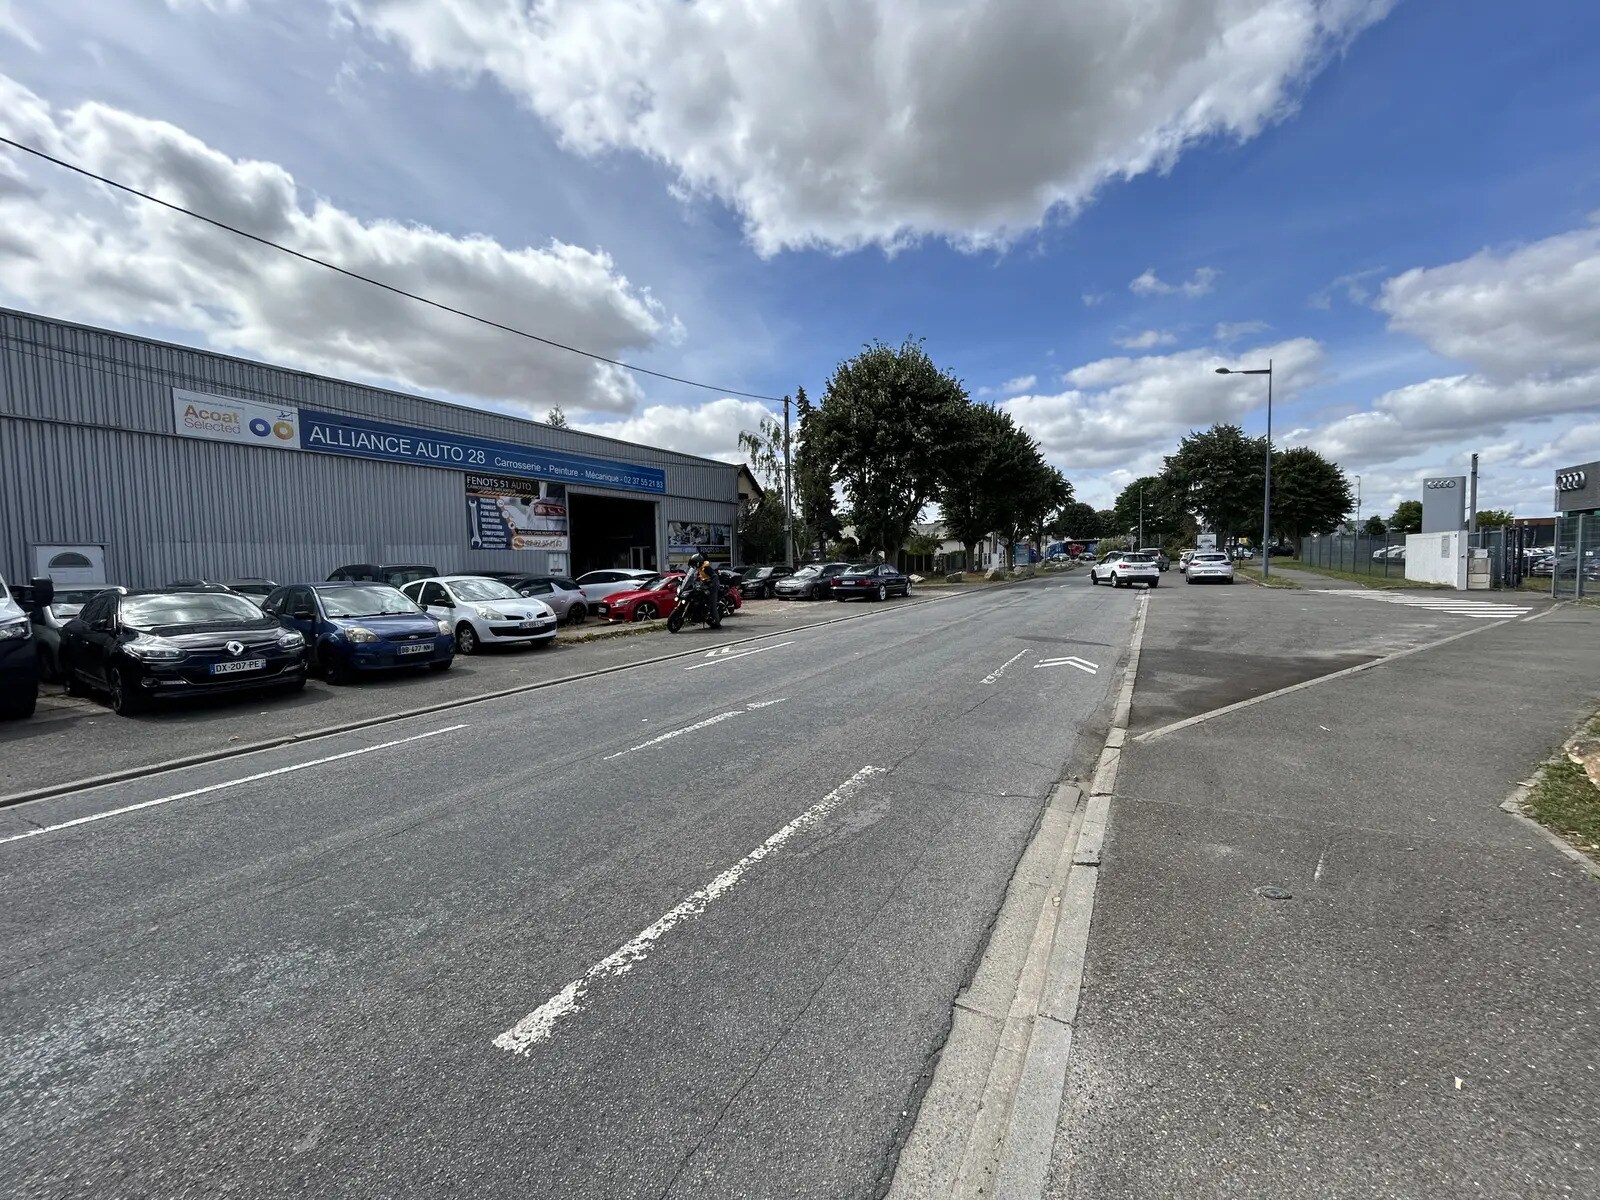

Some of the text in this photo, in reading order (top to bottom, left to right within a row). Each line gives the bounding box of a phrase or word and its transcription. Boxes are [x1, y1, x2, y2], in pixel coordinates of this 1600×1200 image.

[184, 404, 240, 424] Acoat
[184, 418, 241, 434] Selected
[309, 425, 486, 464] ALLIANCE AUTO 28
[494, 457, 541, 472] Carrosserie
[549, 465, 578, 477] Peinture
[585, 470, 619, 483] Mécanique
[623, 476, 631, 484] 02
[632, 477, 639, 485] 37
[648, 479, 655, 487] 21
[656, 480, 663, 489] 83
[467, 476, 532, 491] FENOTS 51 AUTO
